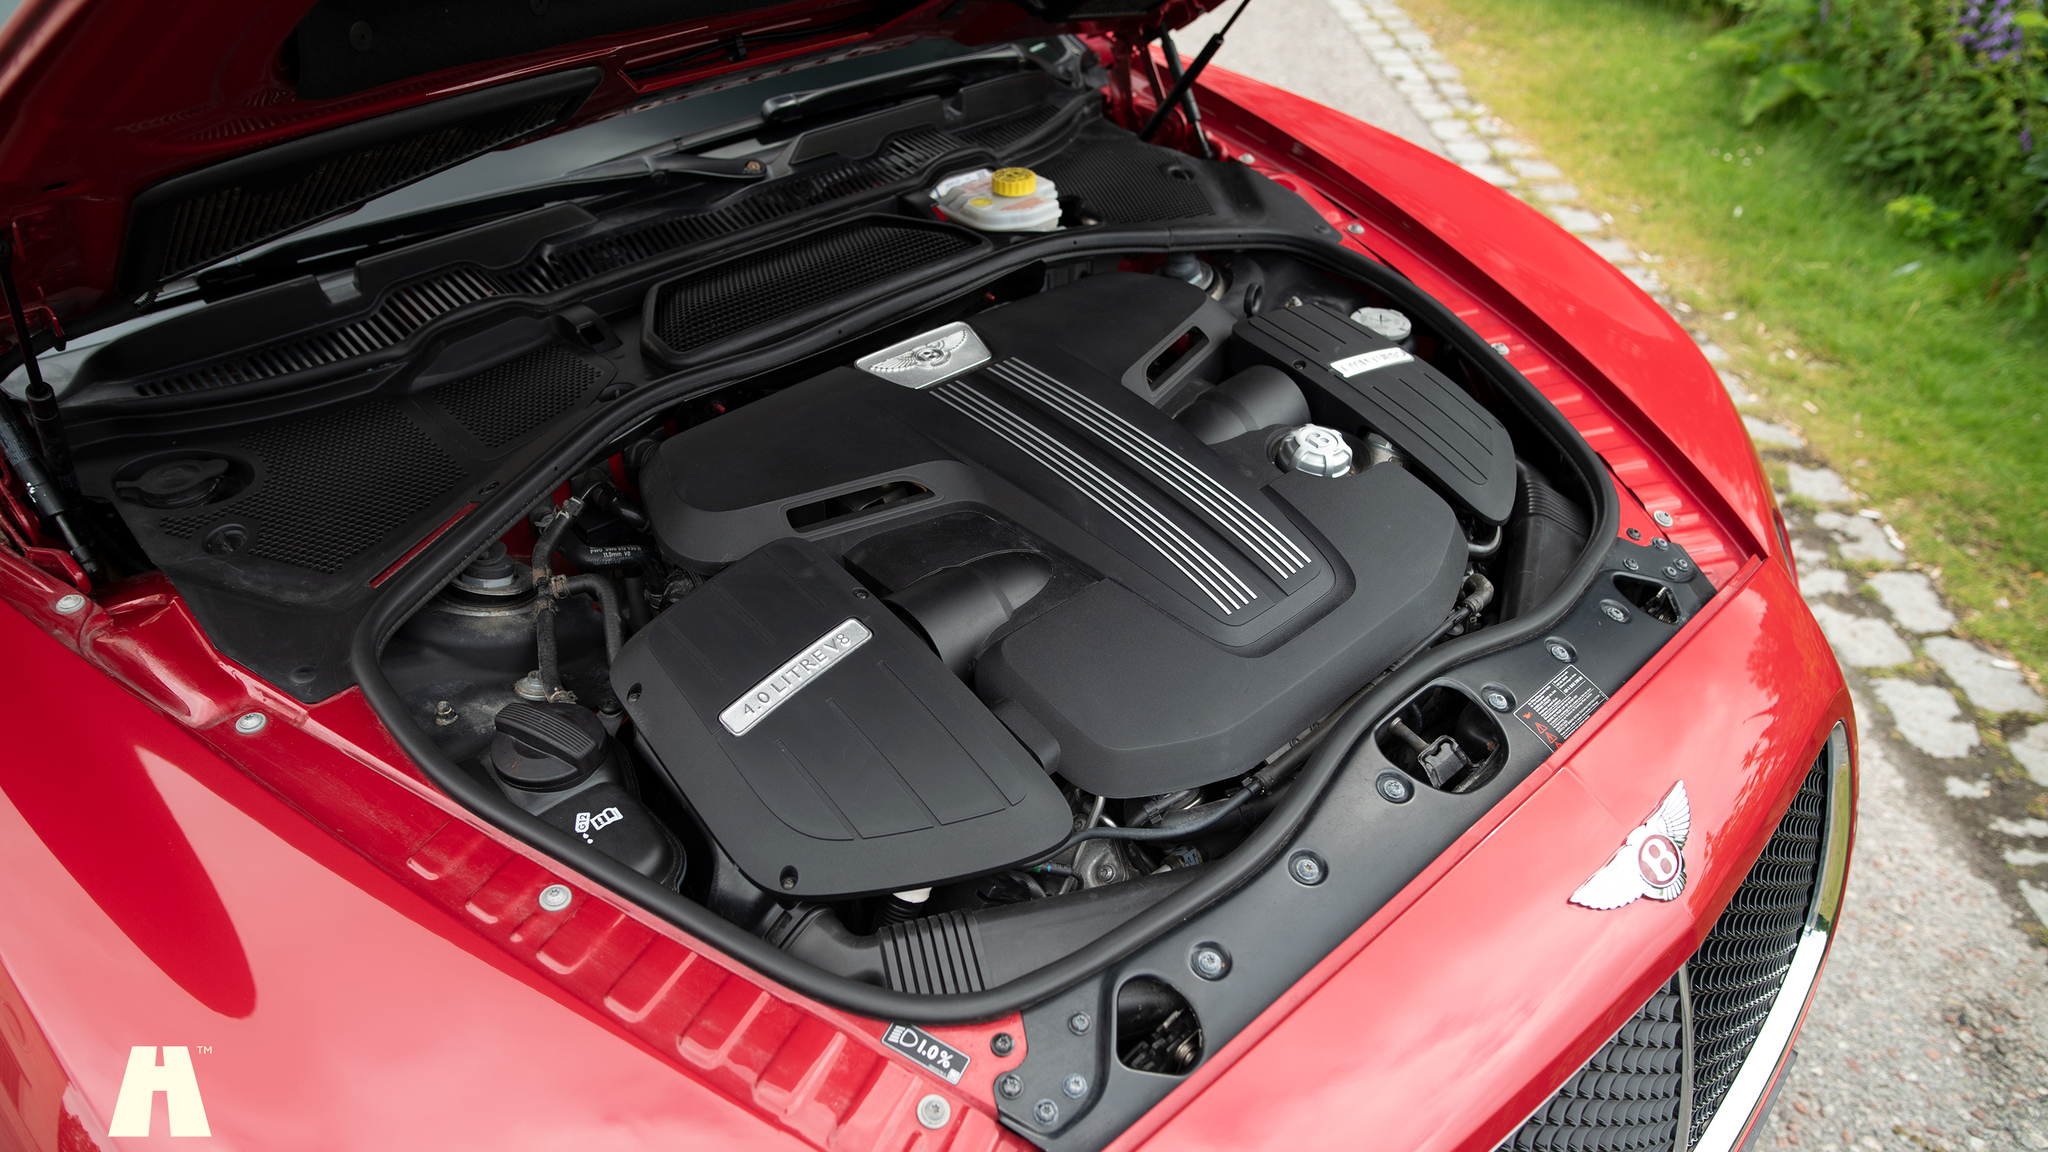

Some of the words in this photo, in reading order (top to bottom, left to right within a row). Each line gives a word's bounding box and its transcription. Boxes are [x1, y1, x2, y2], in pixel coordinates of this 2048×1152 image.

[1305, 432, 1330, 449] B
[744, 691, 771, 715] 4.0
[770, 649, 828, 694] LITRE
[823, 633, 850, 652] V8
[578, 814, 588, 830] G12
[1641, 837, 1679, 882] B
[916, 1038, 954, 1069] 1.0%
